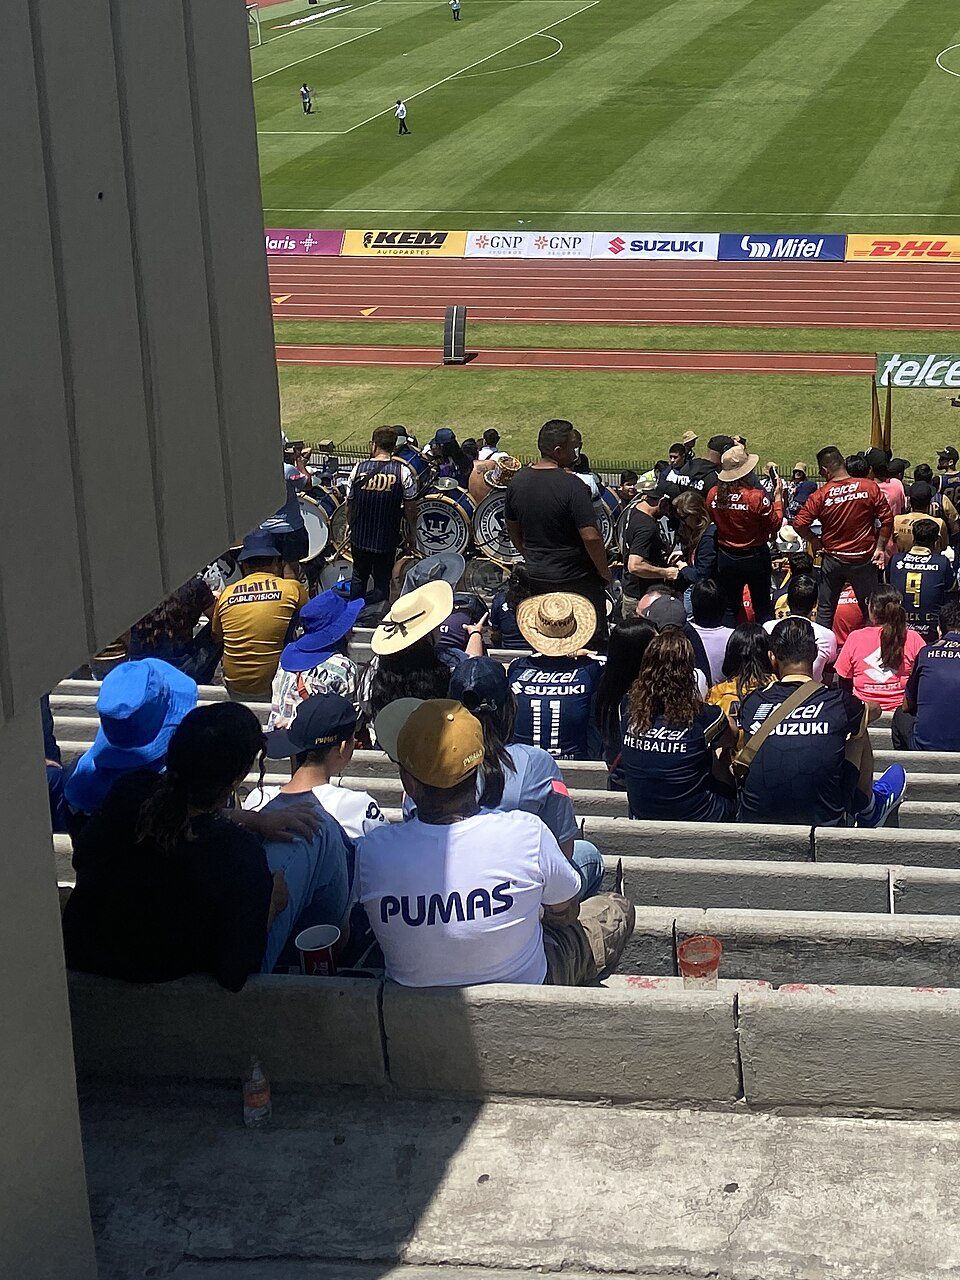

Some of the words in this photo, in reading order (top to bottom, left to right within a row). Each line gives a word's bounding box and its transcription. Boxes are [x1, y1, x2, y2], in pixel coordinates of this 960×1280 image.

[374, 231, 449, 245] KEM
[490, 236, 523, 249] GNP
[549, 236, 582, 249] GNP
[629, 240, 703, 253] SUZUKI
[772, 238, 824, 257] Mifel
[868, 240, 951, 257] DHL
[829, 481, 860, 497] telcel
[834, 491, 869, 504] SUZUKI
[904, 562, 939, 571] SUZUKI
[906, 571, 922, 608] 9
[228, 592, 280, 604] CABLEVISION
[531, 669, 579, 683] telcel
[524, 684, 585, 696] SUZUKI
[623, 734, 687, 753] HERBALIFE
[379, 880, 514, 927] PUMAS
